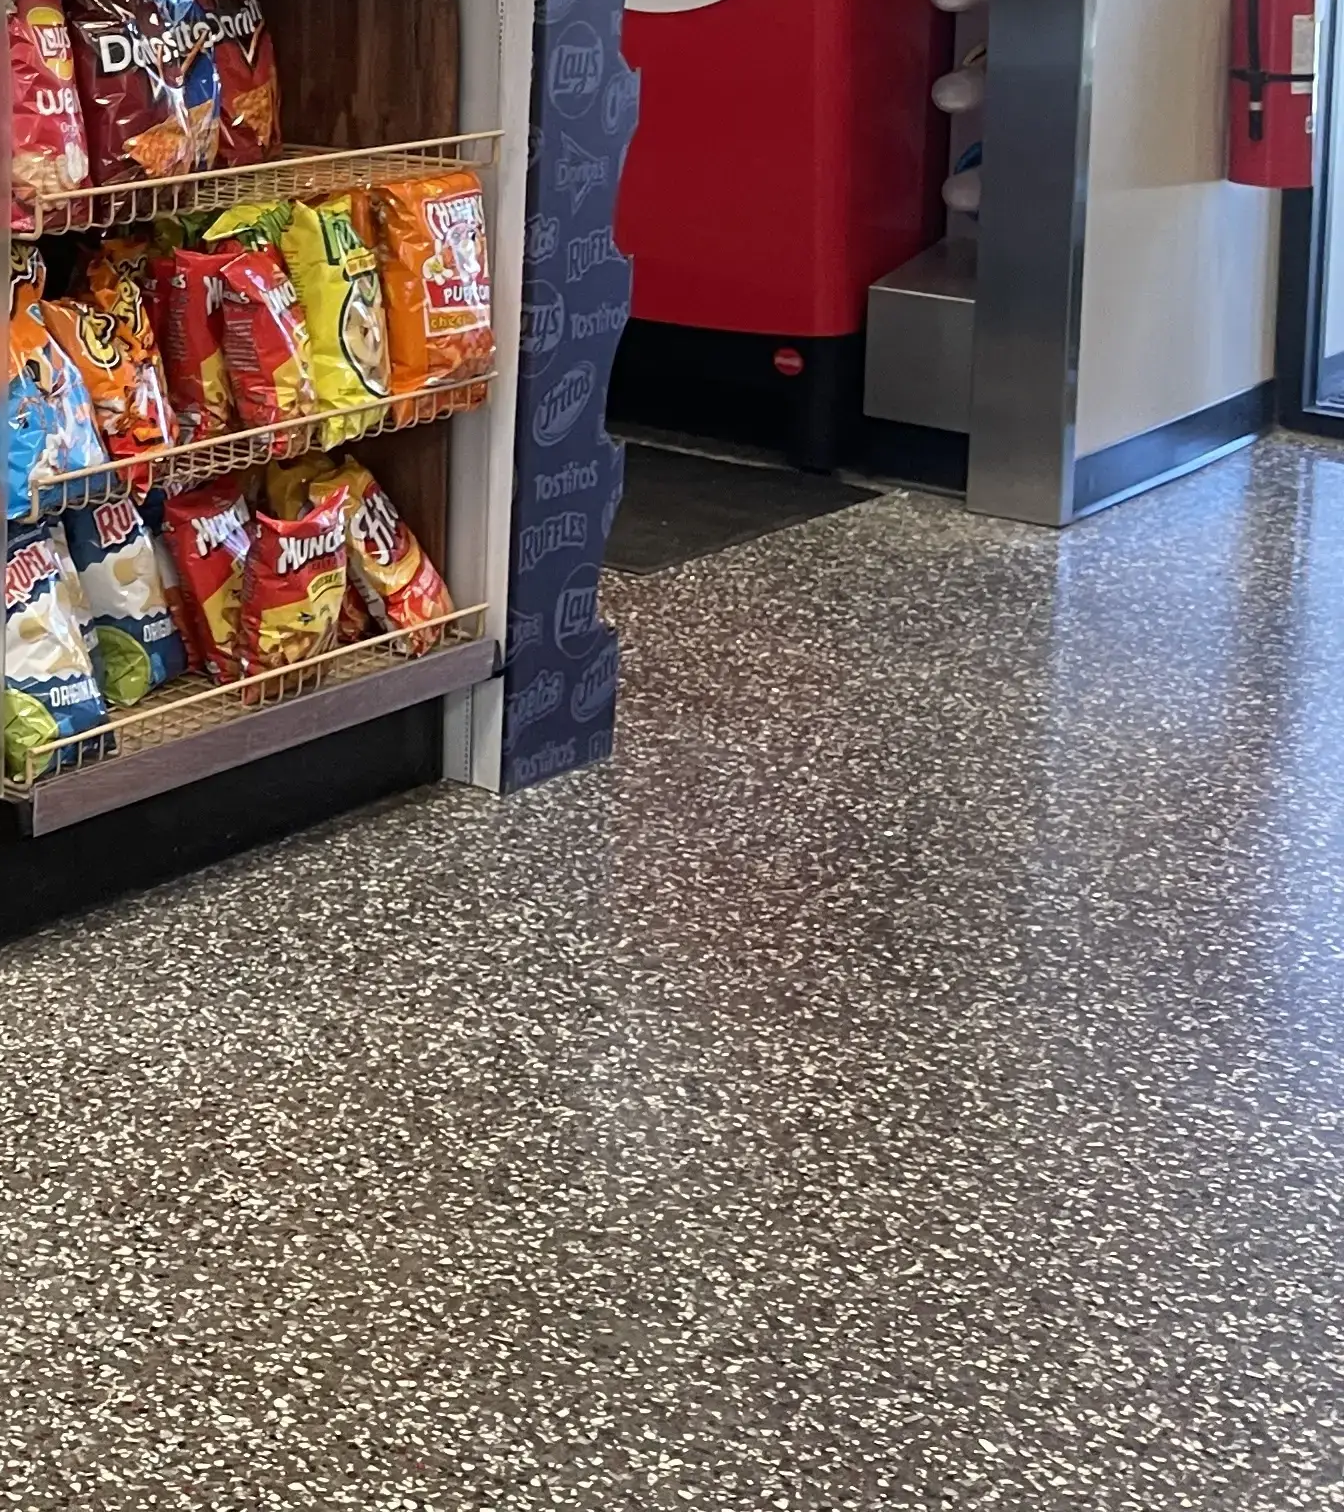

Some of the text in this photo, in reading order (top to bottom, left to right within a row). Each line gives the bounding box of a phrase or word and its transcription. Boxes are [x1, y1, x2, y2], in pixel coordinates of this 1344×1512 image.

[556, 44, 600, 96] Lay's
[566, 226, 615, 283] RUFFL
[534, 459, 598, 503] Tostitos
[519, 514, 587, 573] RUFFLES
[559, 593, 596, 638] Lay
